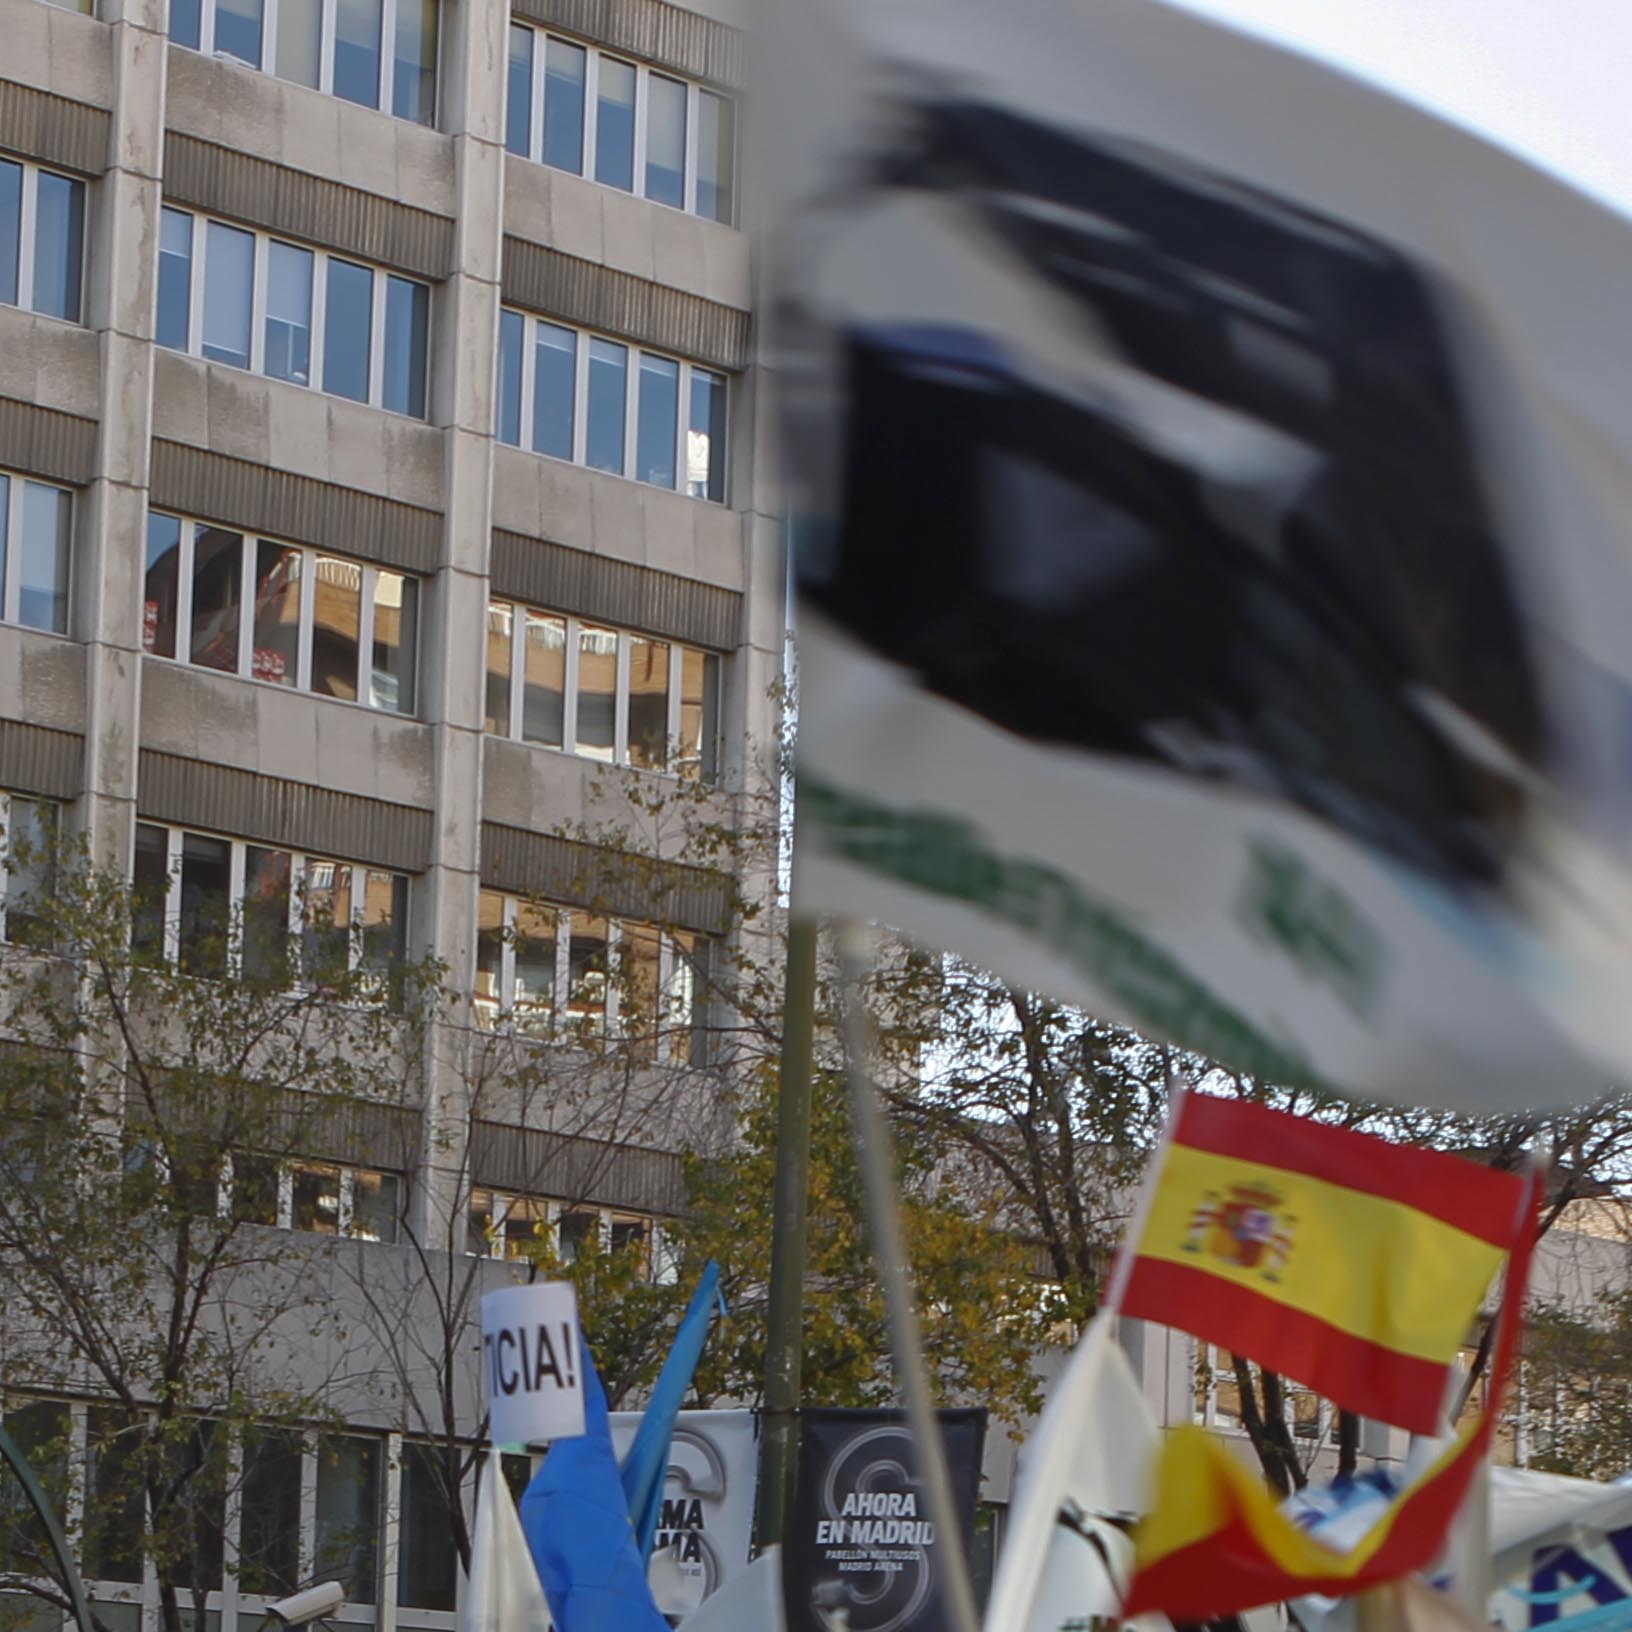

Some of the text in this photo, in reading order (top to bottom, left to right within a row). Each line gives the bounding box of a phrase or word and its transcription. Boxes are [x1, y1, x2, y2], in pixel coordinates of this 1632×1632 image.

[842, 1493, 916, 1517] AHORA
[816, 1520, 935, 1545] EN MADRID
